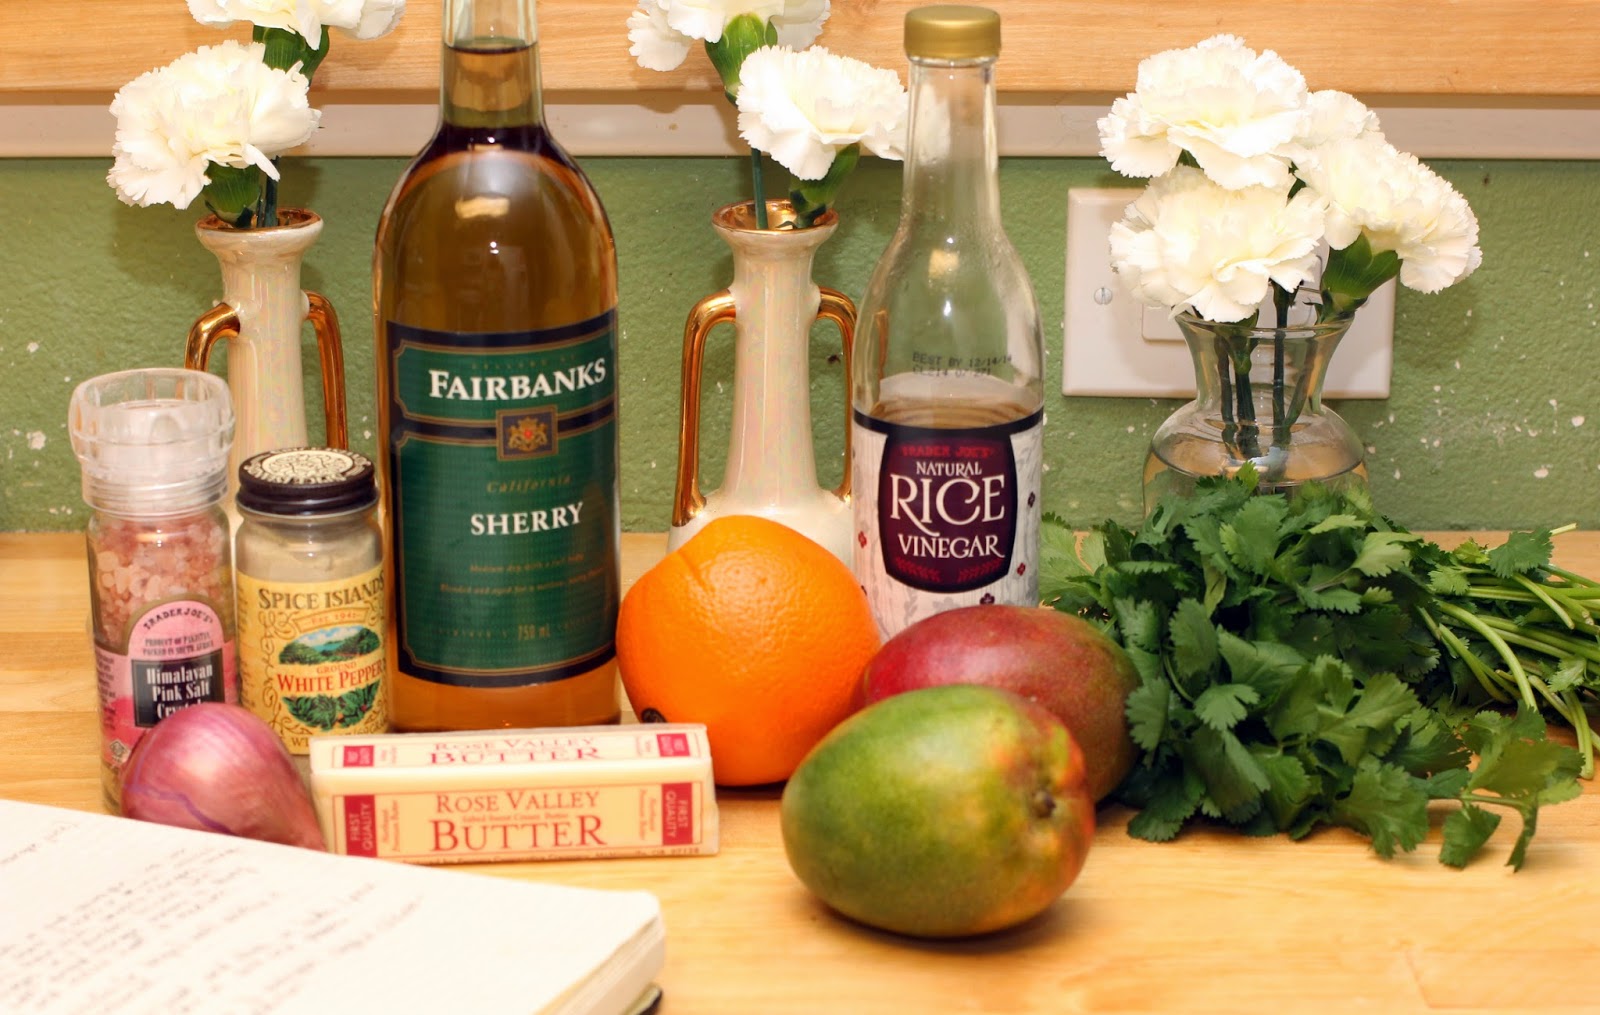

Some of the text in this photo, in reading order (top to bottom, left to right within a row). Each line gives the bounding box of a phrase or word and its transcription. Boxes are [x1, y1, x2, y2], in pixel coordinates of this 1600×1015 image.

[912, 352, 942, 365] BEST
[428, 358, 606, 401] FAIRBANKS
[915, 461, 982, 478] NATURAL
[471, 501, 584, 536] SHERRY
[890, 474, 1005, 537] RICE
[898, 533, 1005, 559] VINEGAR
[258, 588, 320, 611] SPICE
[143, 608, 183, 630] TRADER
[146, 664, 213, 685] Himalayan
[277, 673, 333, 692] WHITE
[339, 660, 383, 689] PEPPER
[316, 662, 356, 675] GROUND
[152, 681, 210, 702] Pink Salt
[429, 748, 603, 764] BUTTER
[436, 789, 600, 813] ROSE VALLEY
[665, 790, 678, 838] QUALITY
[676, 799, 689, 829] FIRST
[348, 812, 361, 842] FIRST
[360, 803, 373, 851] QUALITY
[429, 815, 608, 852] BUTTER
